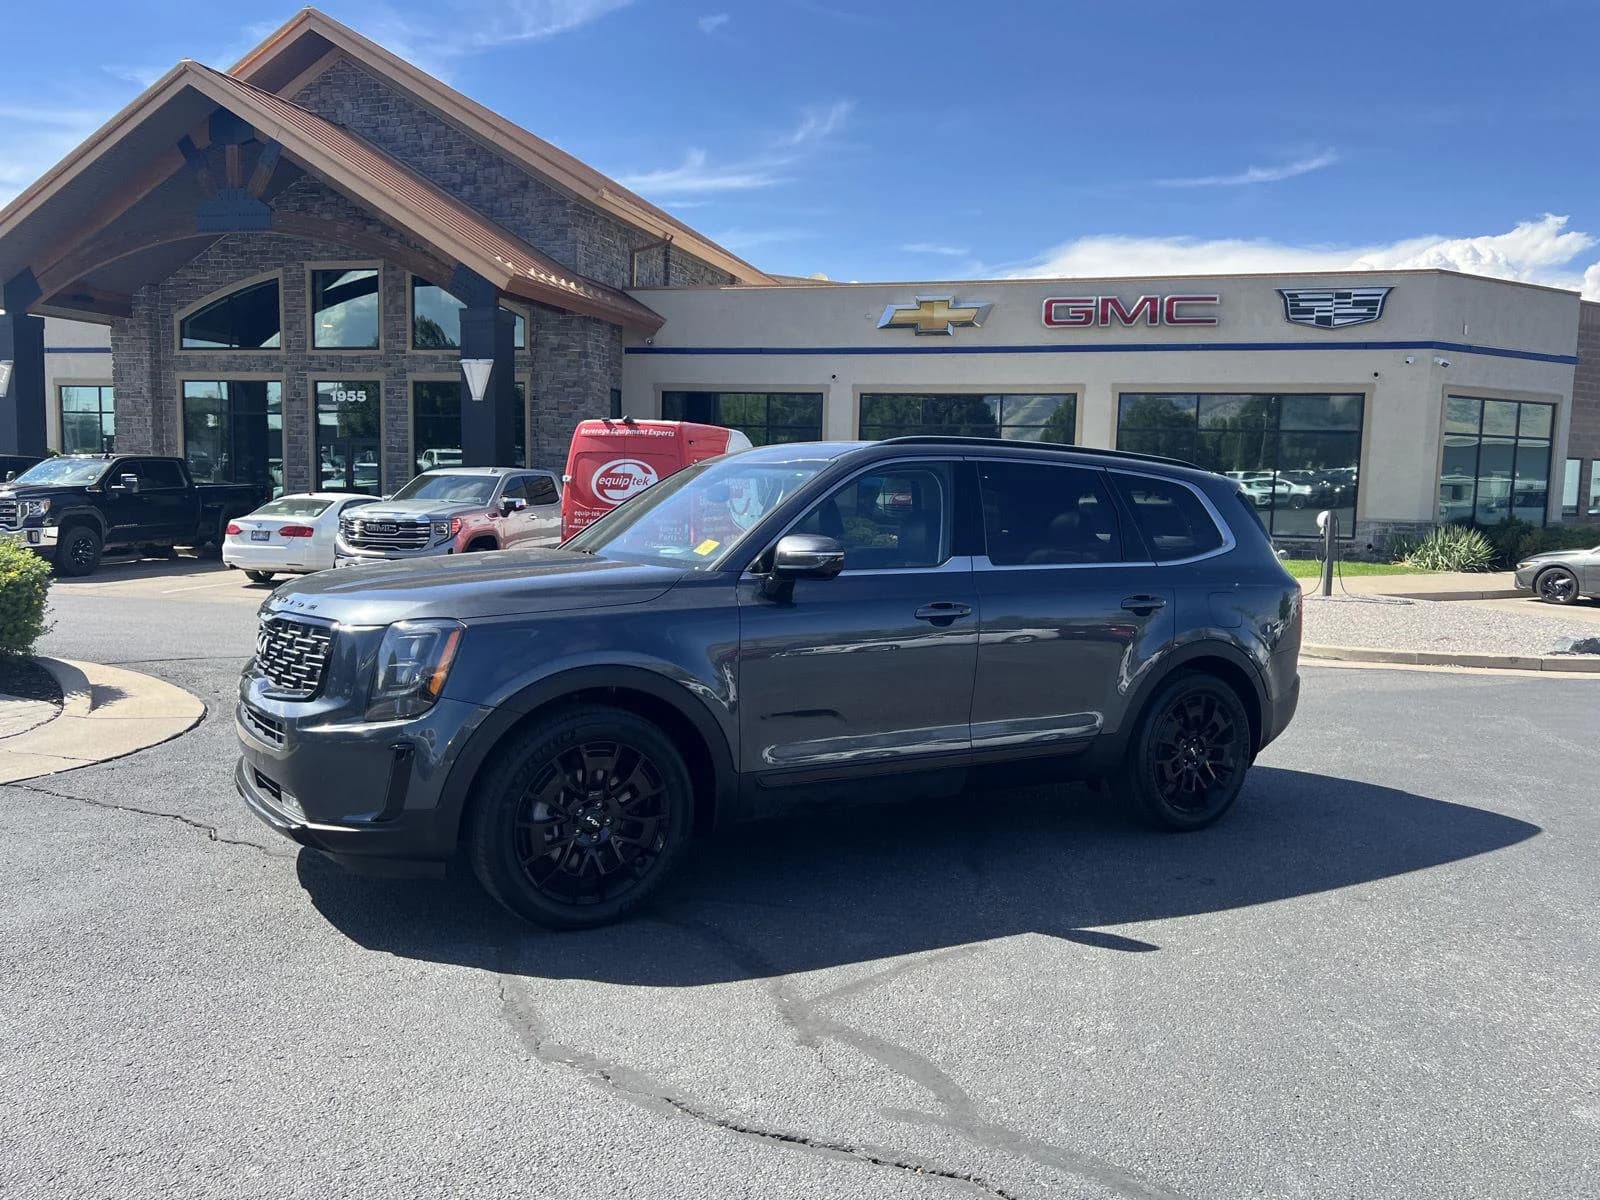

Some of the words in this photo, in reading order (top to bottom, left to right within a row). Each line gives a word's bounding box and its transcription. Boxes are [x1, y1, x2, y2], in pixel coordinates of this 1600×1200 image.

[1042, 294, 1220, 328] GMC
[330, 390, 367, 402] 1955
[581, 427, 609, 436] Beverage
[610, 428, 648, 436] Equipment
[648, 429, 675, 437] Experts
[366, 523, 397, 532] GMC
